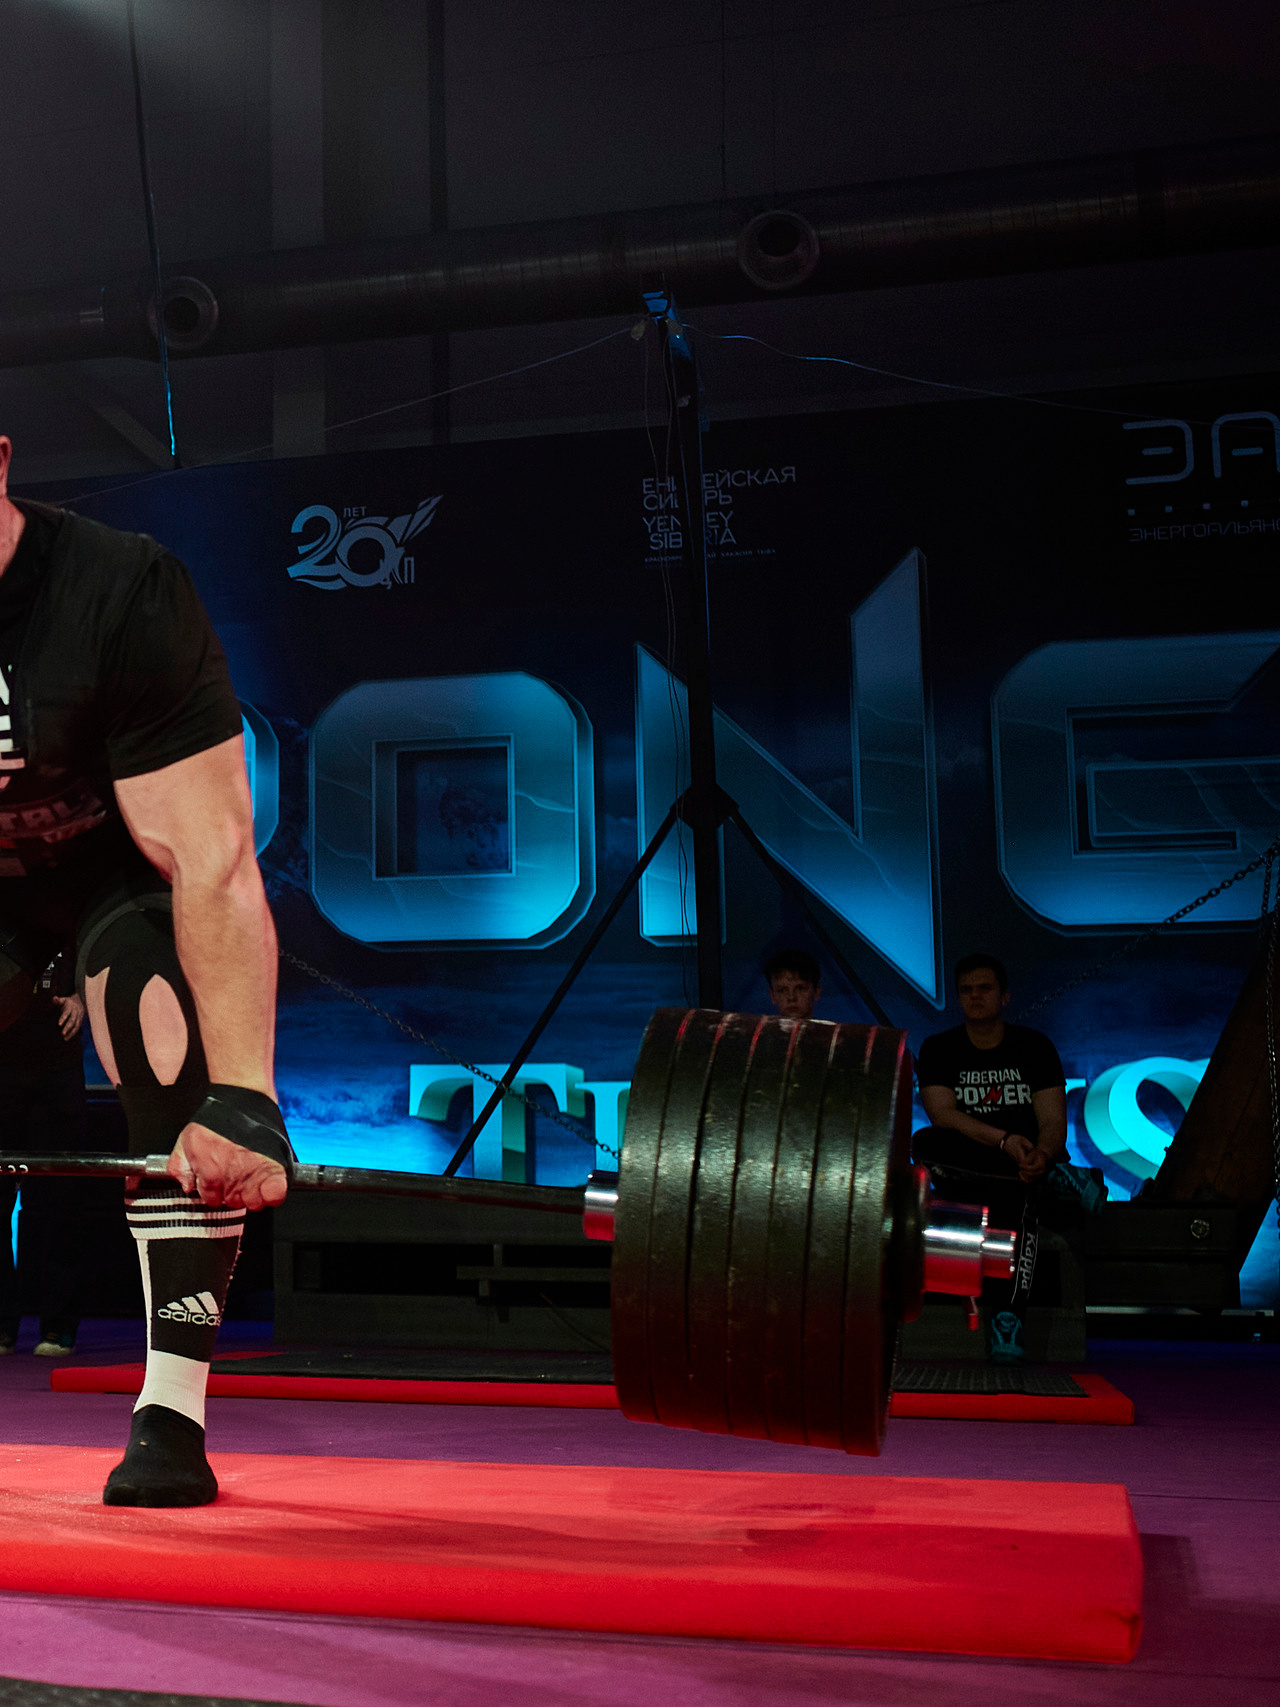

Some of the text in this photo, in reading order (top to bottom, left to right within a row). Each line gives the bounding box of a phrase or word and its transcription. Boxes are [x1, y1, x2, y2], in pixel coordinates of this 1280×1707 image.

[343, 505, 368, 518] ЛЕТ
[959, 1067, 1022, 1085] SIBERIAN
[1020, 1231, 1036, 1291] Kappa
